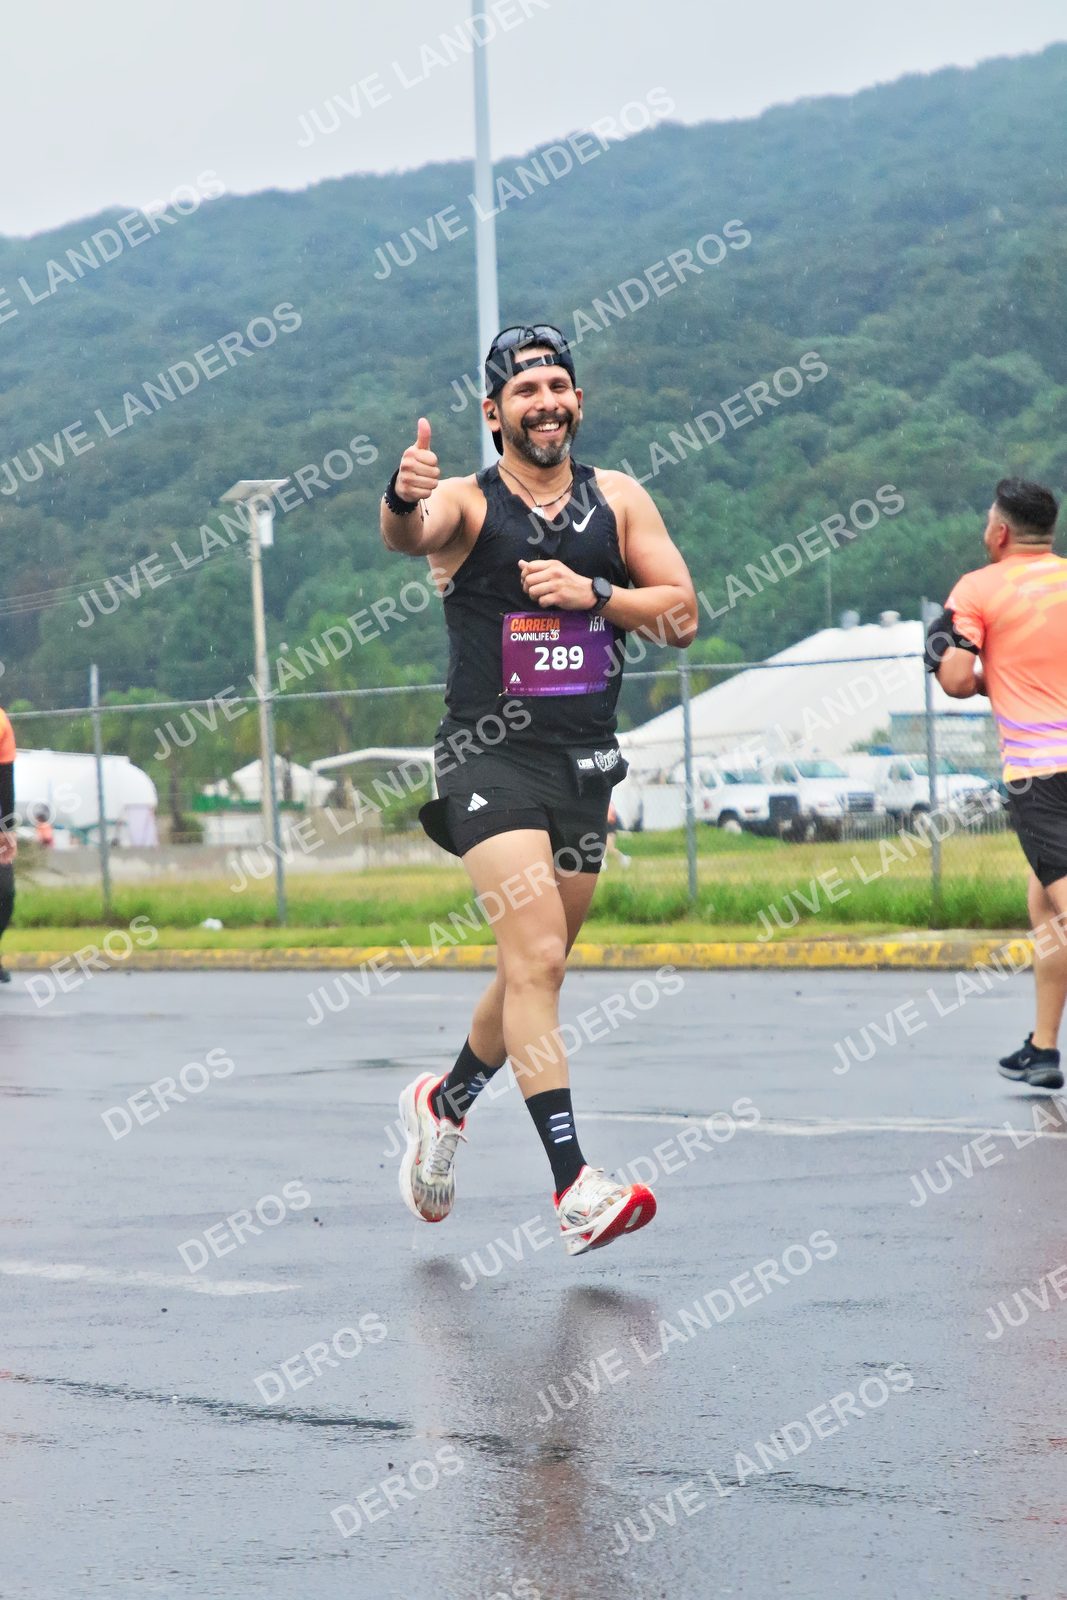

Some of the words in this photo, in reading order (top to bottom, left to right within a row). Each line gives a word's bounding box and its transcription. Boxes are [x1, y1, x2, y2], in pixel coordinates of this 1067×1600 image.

[510, 618, 560, 632] CARRERA
[589, 615, 605, 632] 15K
[534, 645, 584, 671] 289
